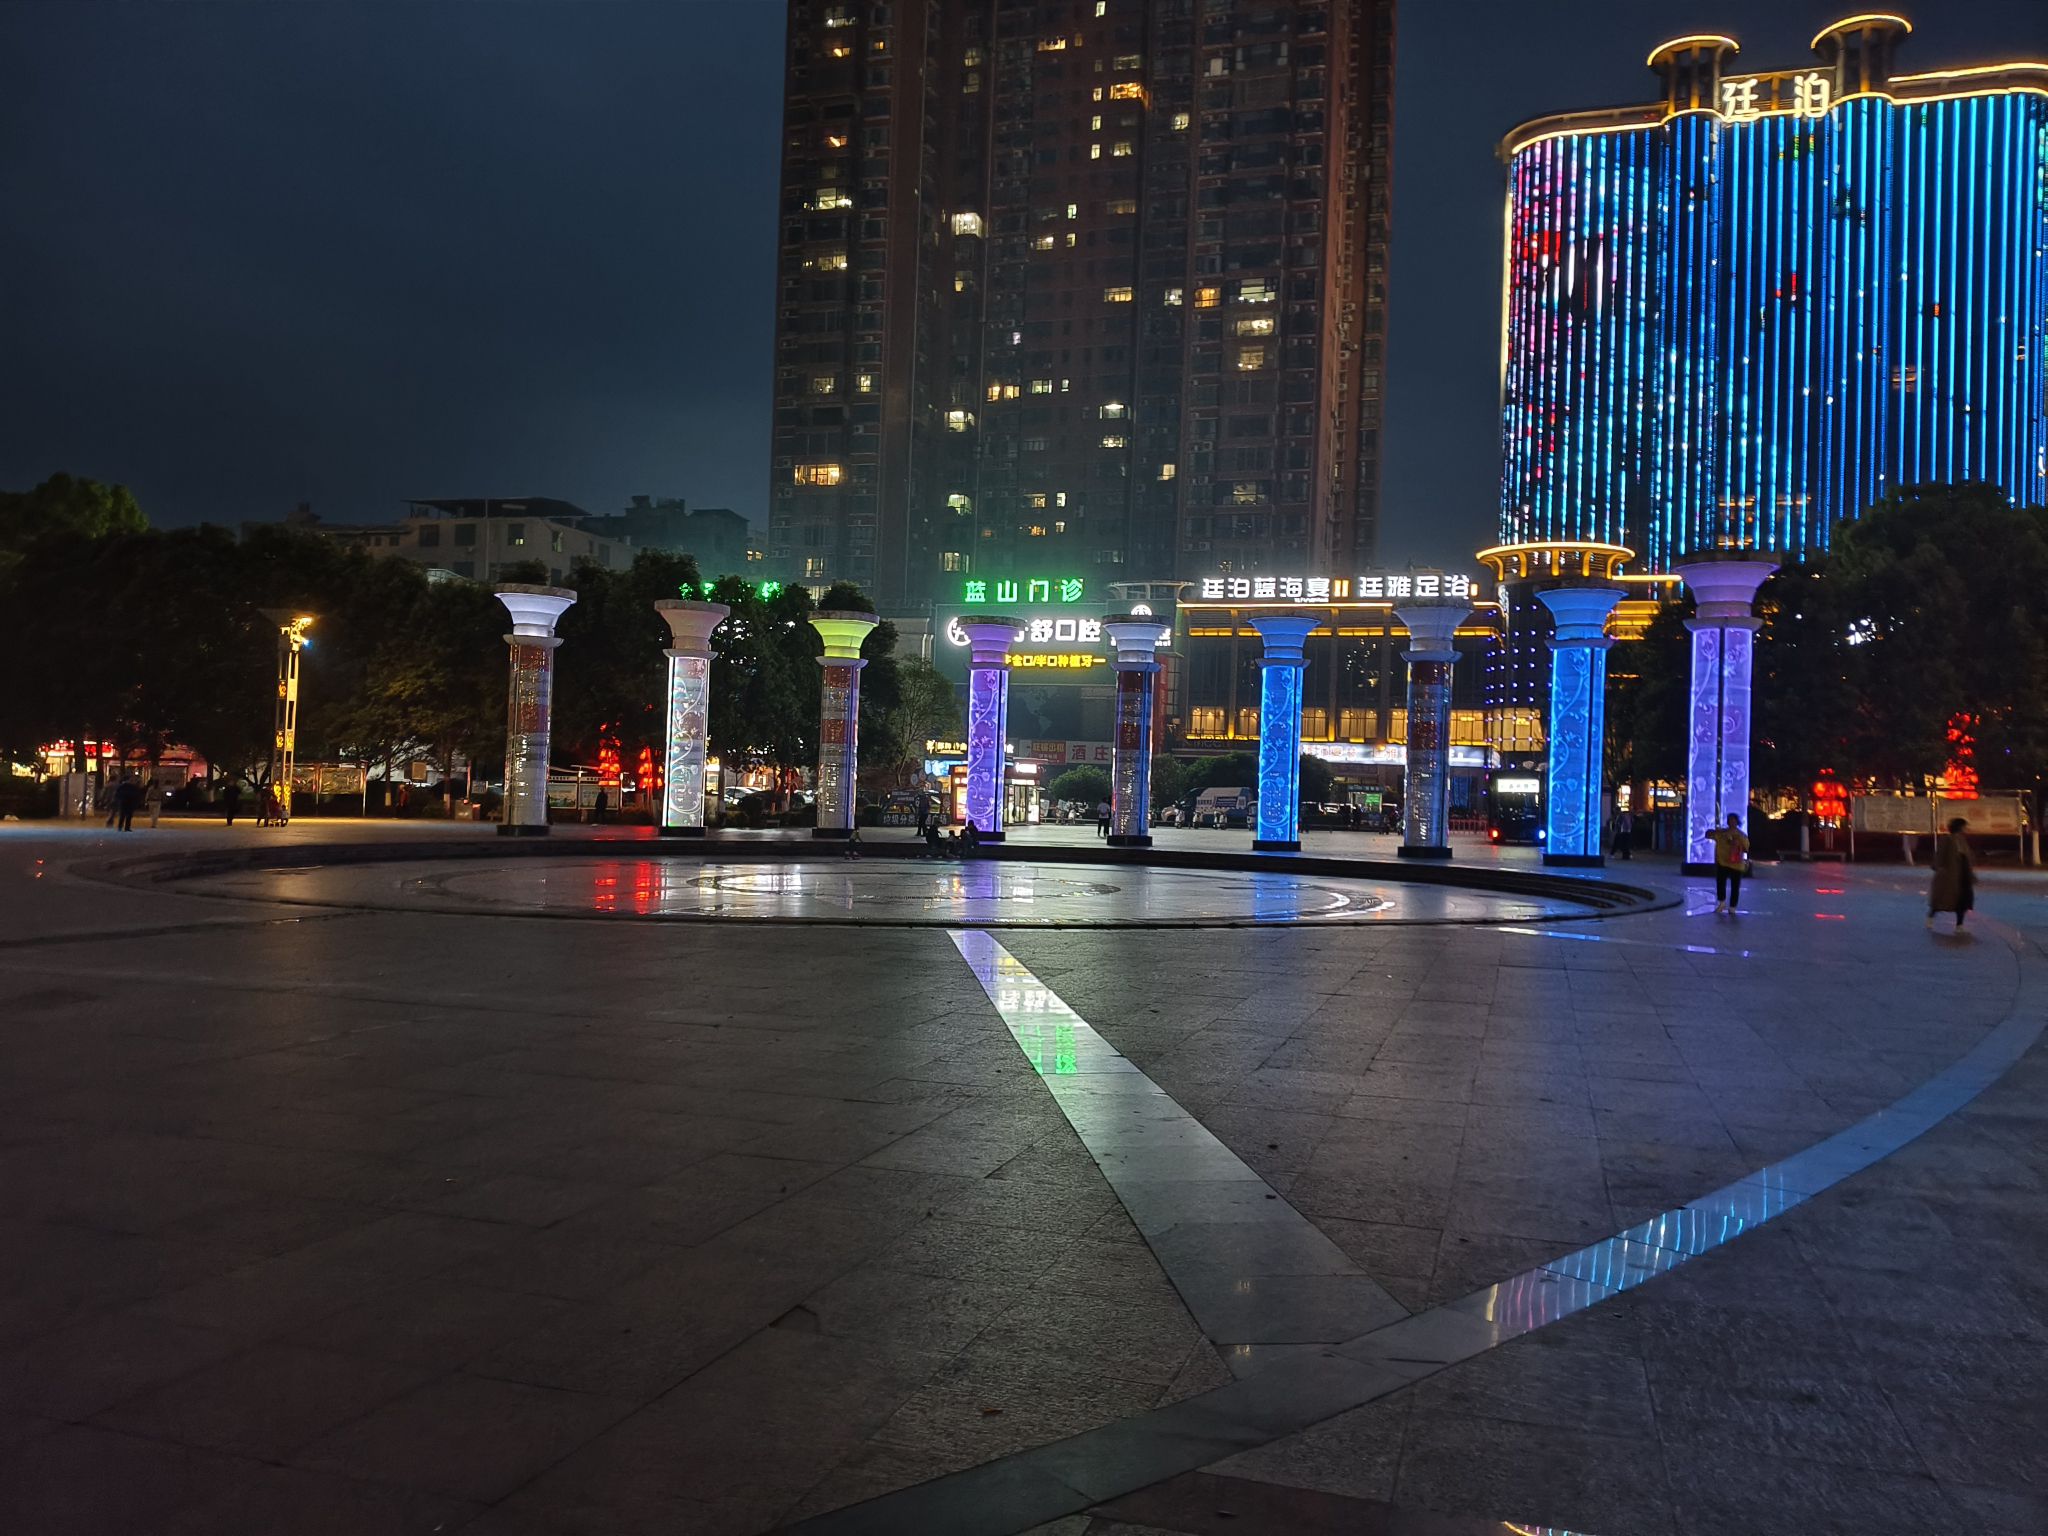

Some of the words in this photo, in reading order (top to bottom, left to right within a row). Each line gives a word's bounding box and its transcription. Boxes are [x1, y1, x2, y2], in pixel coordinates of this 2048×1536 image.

[965, 579, 1084, 602] 蓝山门诊
[1071, 744, 1109, 762] 酒庄
